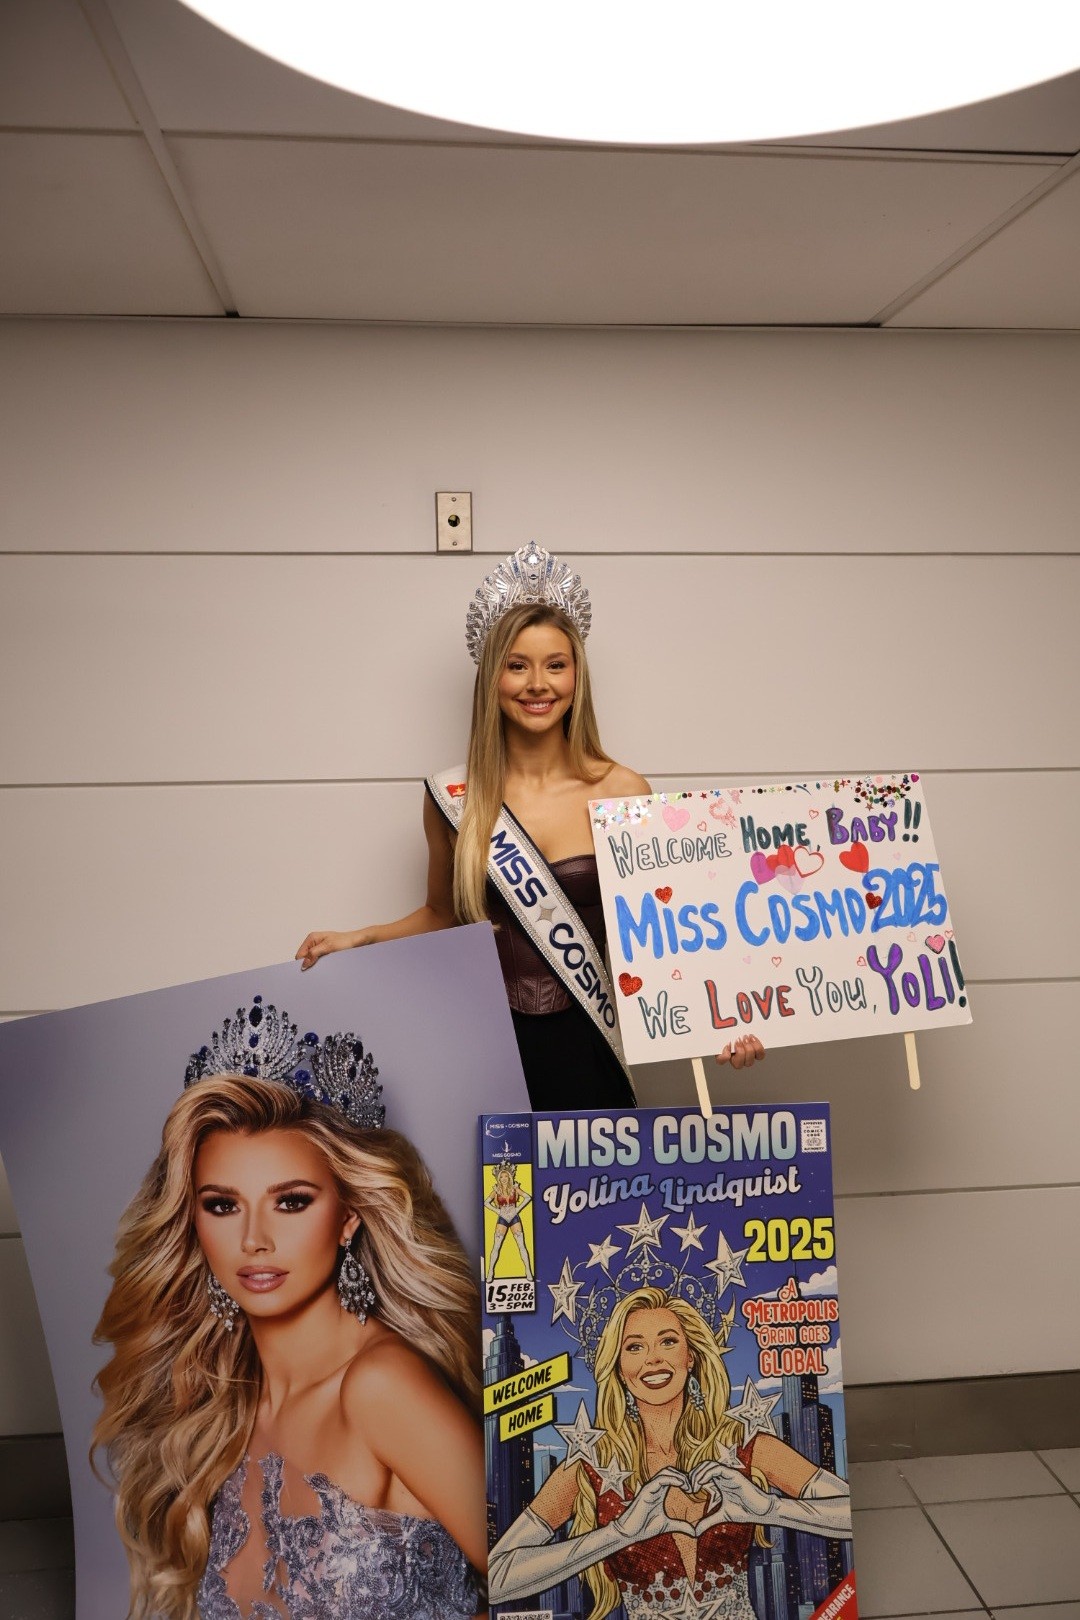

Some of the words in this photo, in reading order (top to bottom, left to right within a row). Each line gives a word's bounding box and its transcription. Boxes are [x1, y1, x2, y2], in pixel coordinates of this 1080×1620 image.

[608, 831, 732, 878] WELCOME
[740, 815, 821, 853] HOME,
[735, 880, 866, 947] COSMO
[862, 862, 948, 933] 2025
[491, 830, 547, 908] MISS
[549, 923, 615, 1028] COSMO
[638, 990, 691, 1039] WE
[704, 979, 796, 1029] LOVE
[537, 1116, 641, 1169] MISS
[653, 1111, 797, 1165] COSMO
[543, 1174, 655, 1225] Yolina
[659, 1165, 802, 1213] Lindquist
[743, 1217, 835, 1263] 2025
[487, 1284, 508, 1303] 15
[510, 1283, 534, 1292] FEB.
[507, 1292, 534, 1302] 2026
[779, 1277, 798, 1300] A
[742, 1300, 839, 1329] METROPOLIS
[755, 1325, 796, 1348] ORGIN
[800, 1325, 830, 1344] GOES
[760, 1348, 828, 1376] GLOBAL
[492, 1365, 552, 1405] WELCOME
[508, 1403, 543, 1433] HOME
[817, 1584, 855, 1620] EARANCE
